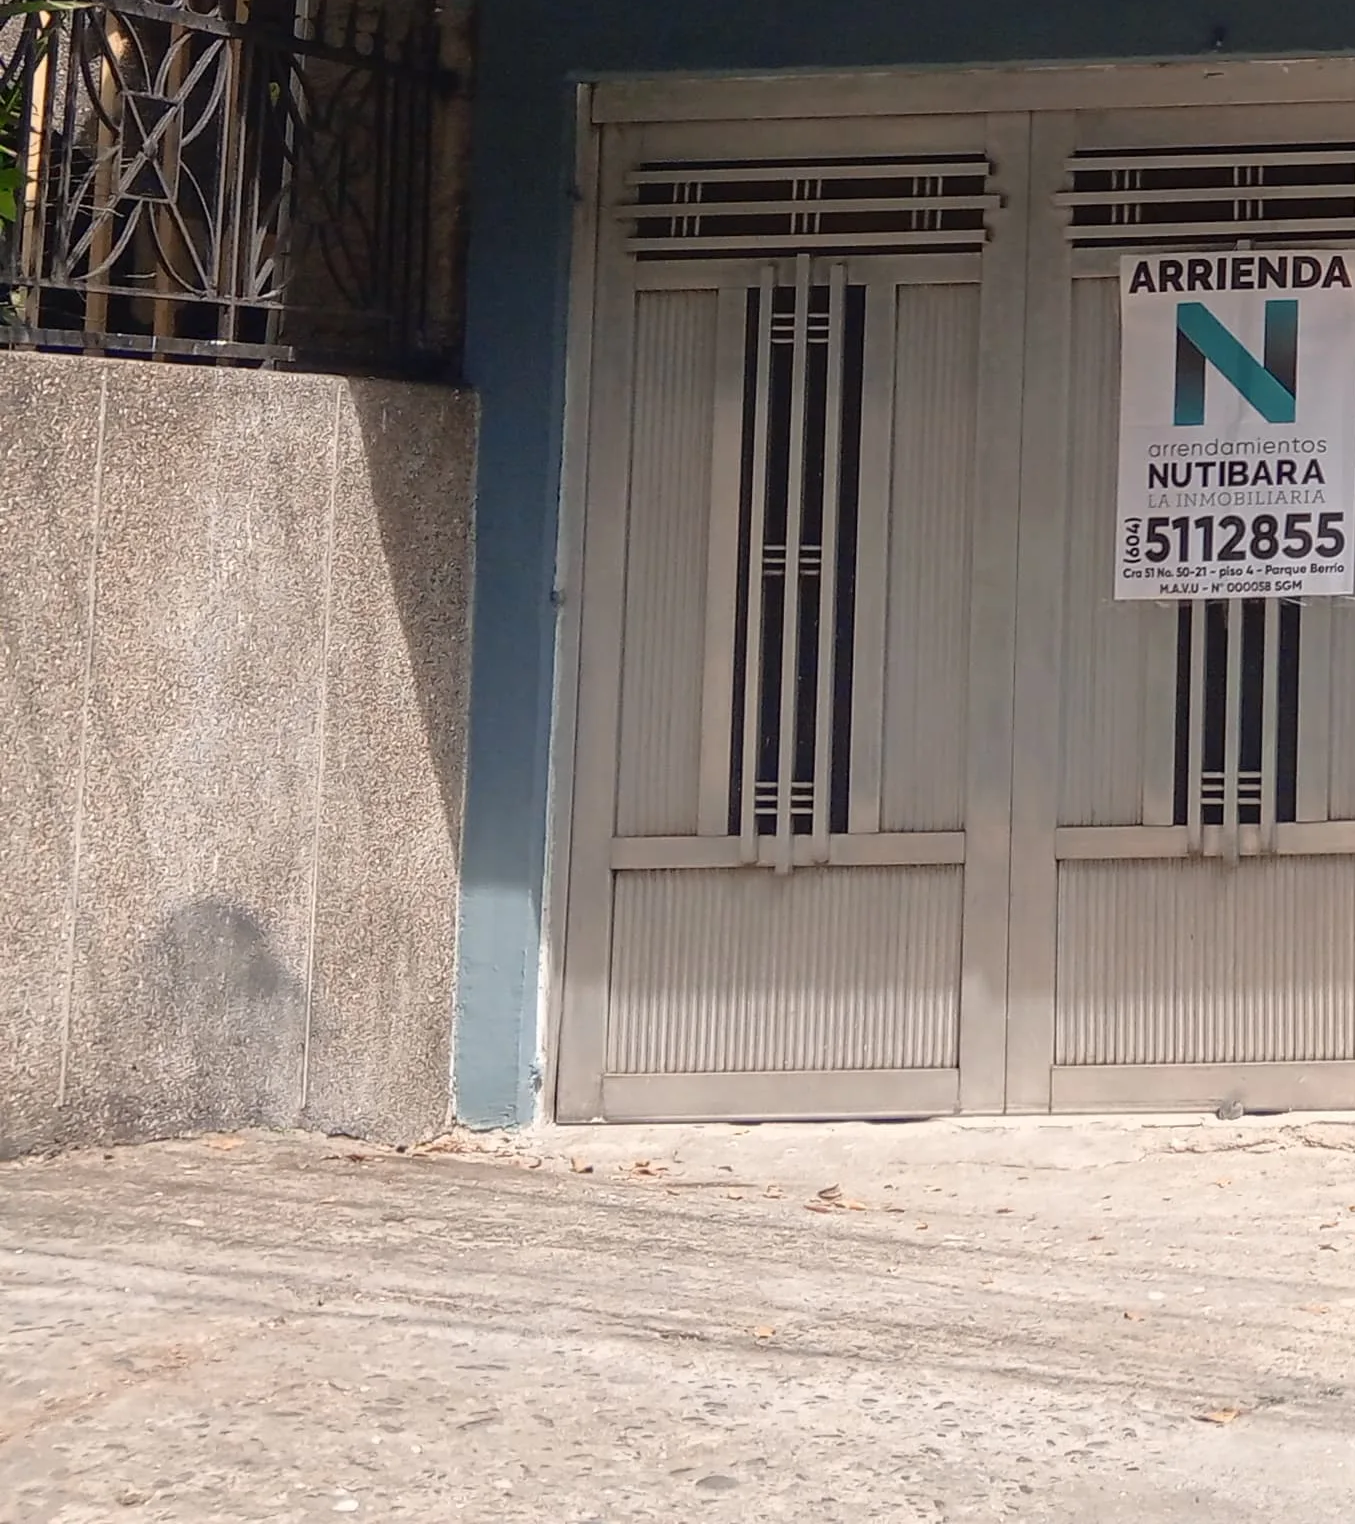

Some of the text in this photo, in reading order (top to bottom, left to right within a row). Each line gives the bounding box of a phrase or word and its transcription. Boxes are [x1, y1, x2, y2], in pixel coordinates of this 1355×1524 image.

[1128, 255, 1352, 294] ARRIENDA
[1174, 299, 1298, 426] N
[1148, 438, 1328, 458] arrendamientos
[1148, 459, 1326, 490] NUTIBARA
[1148, 489, 1326, 509] LA INMOBILIARIA
[1122, 517, 1142, 564] (604)
[1144, 512, 1345, 563] 5112855
[1122, 568, 1142, 578] Cra
[1144, 568, 1154, 578] 51
[1176, 566, 1207, 577] 50-21
[1220, 566, 1244, 578] piso
[1246, 564, 1254, 575] 4
[1264, 564, 1306, 576] Parque
[1227, 581, 1272, 593] 000058
[1274, 580, 1302, 591] SGM
